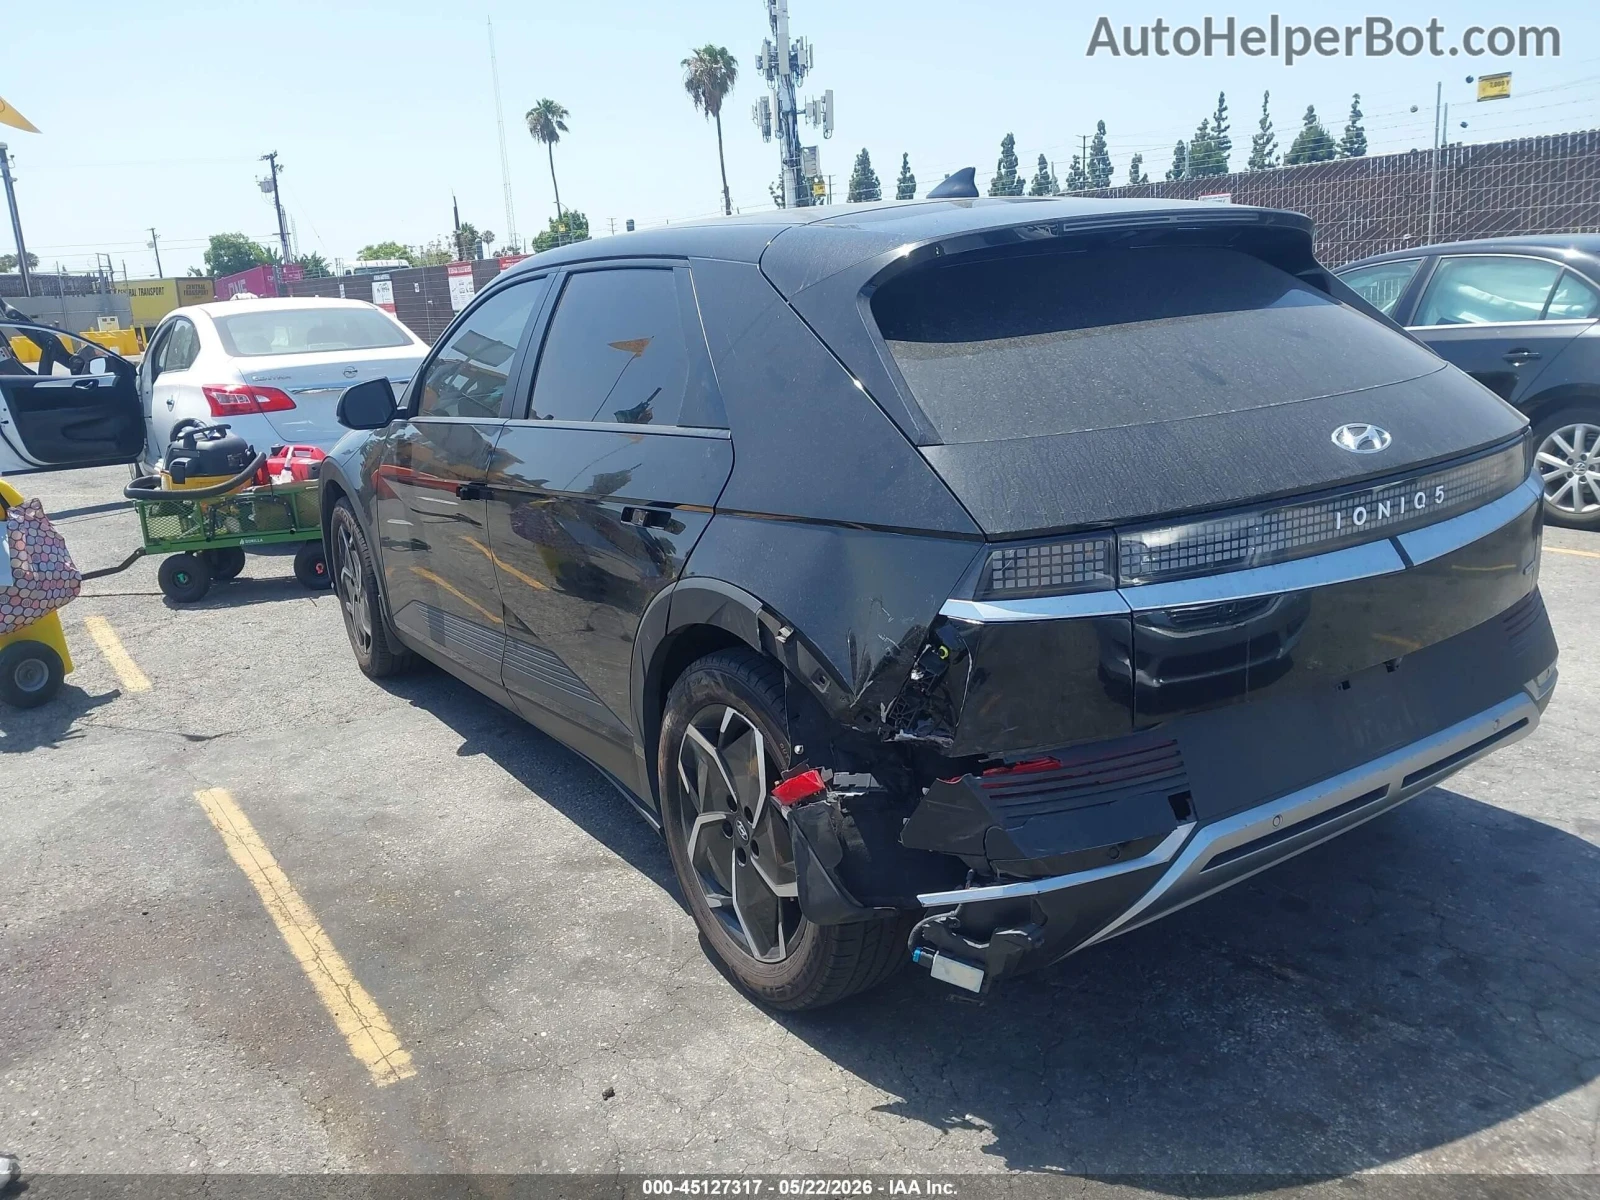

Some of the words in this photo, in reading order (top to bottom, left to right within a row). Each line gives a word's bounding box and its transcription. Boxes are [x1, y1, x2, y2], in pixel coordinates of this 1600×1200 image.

[138, 286, 165, 297] TRANSPORT
[1335, 491, 1426, 530] IONIQ
[1434, 485, 1445, 504] 5
